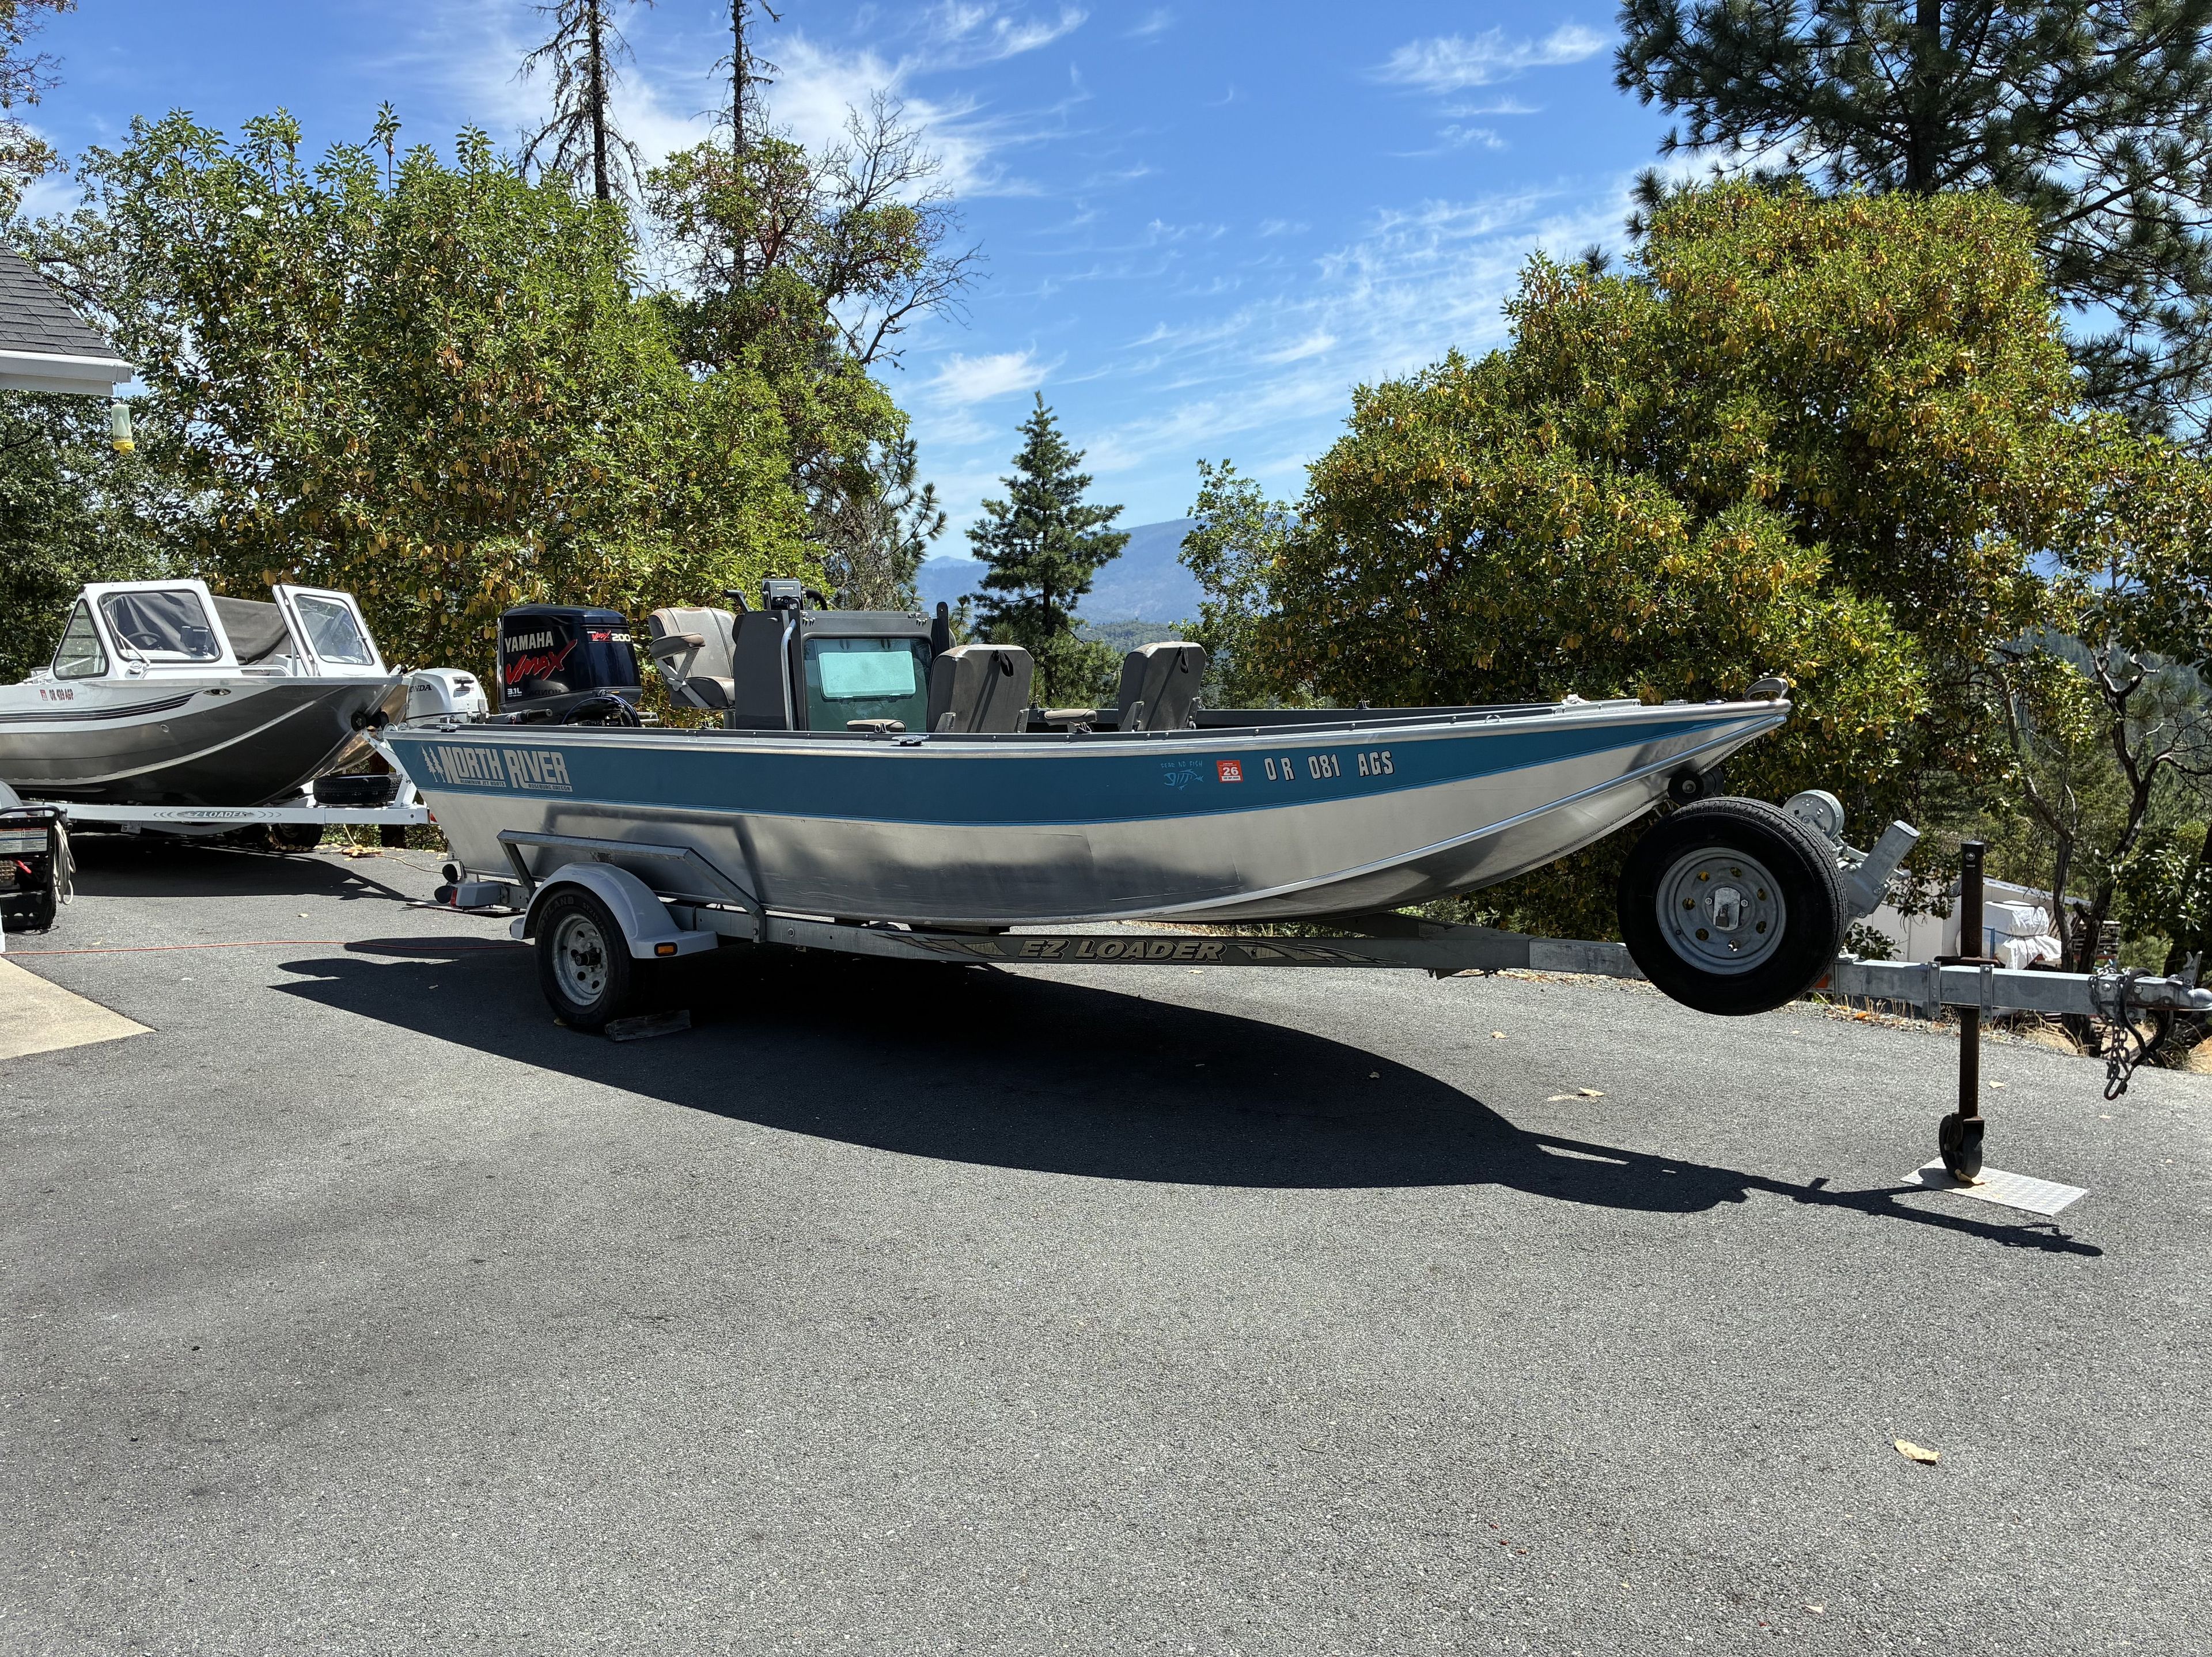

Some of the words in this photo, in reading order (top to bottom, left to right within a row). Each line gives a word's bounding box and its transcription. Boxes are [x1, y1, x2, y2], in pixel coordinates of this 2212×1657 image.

[505, 631, 554, 653] YAMAHA
[611, 634, 631, 642] 200
[507, 687, 522, 695] 3.1L
[437, 746, 505, 784] NORTH
[502, 749, 570, 788] RIVER
[1222, 767, 1239, 776] 26
[1308, 754, 1341, 780] 081
[1357, 750, 1395, 777] AGS
[1018, 939, 1070, 960] EZ
[1075, 939, 1226, 962] LOADER
